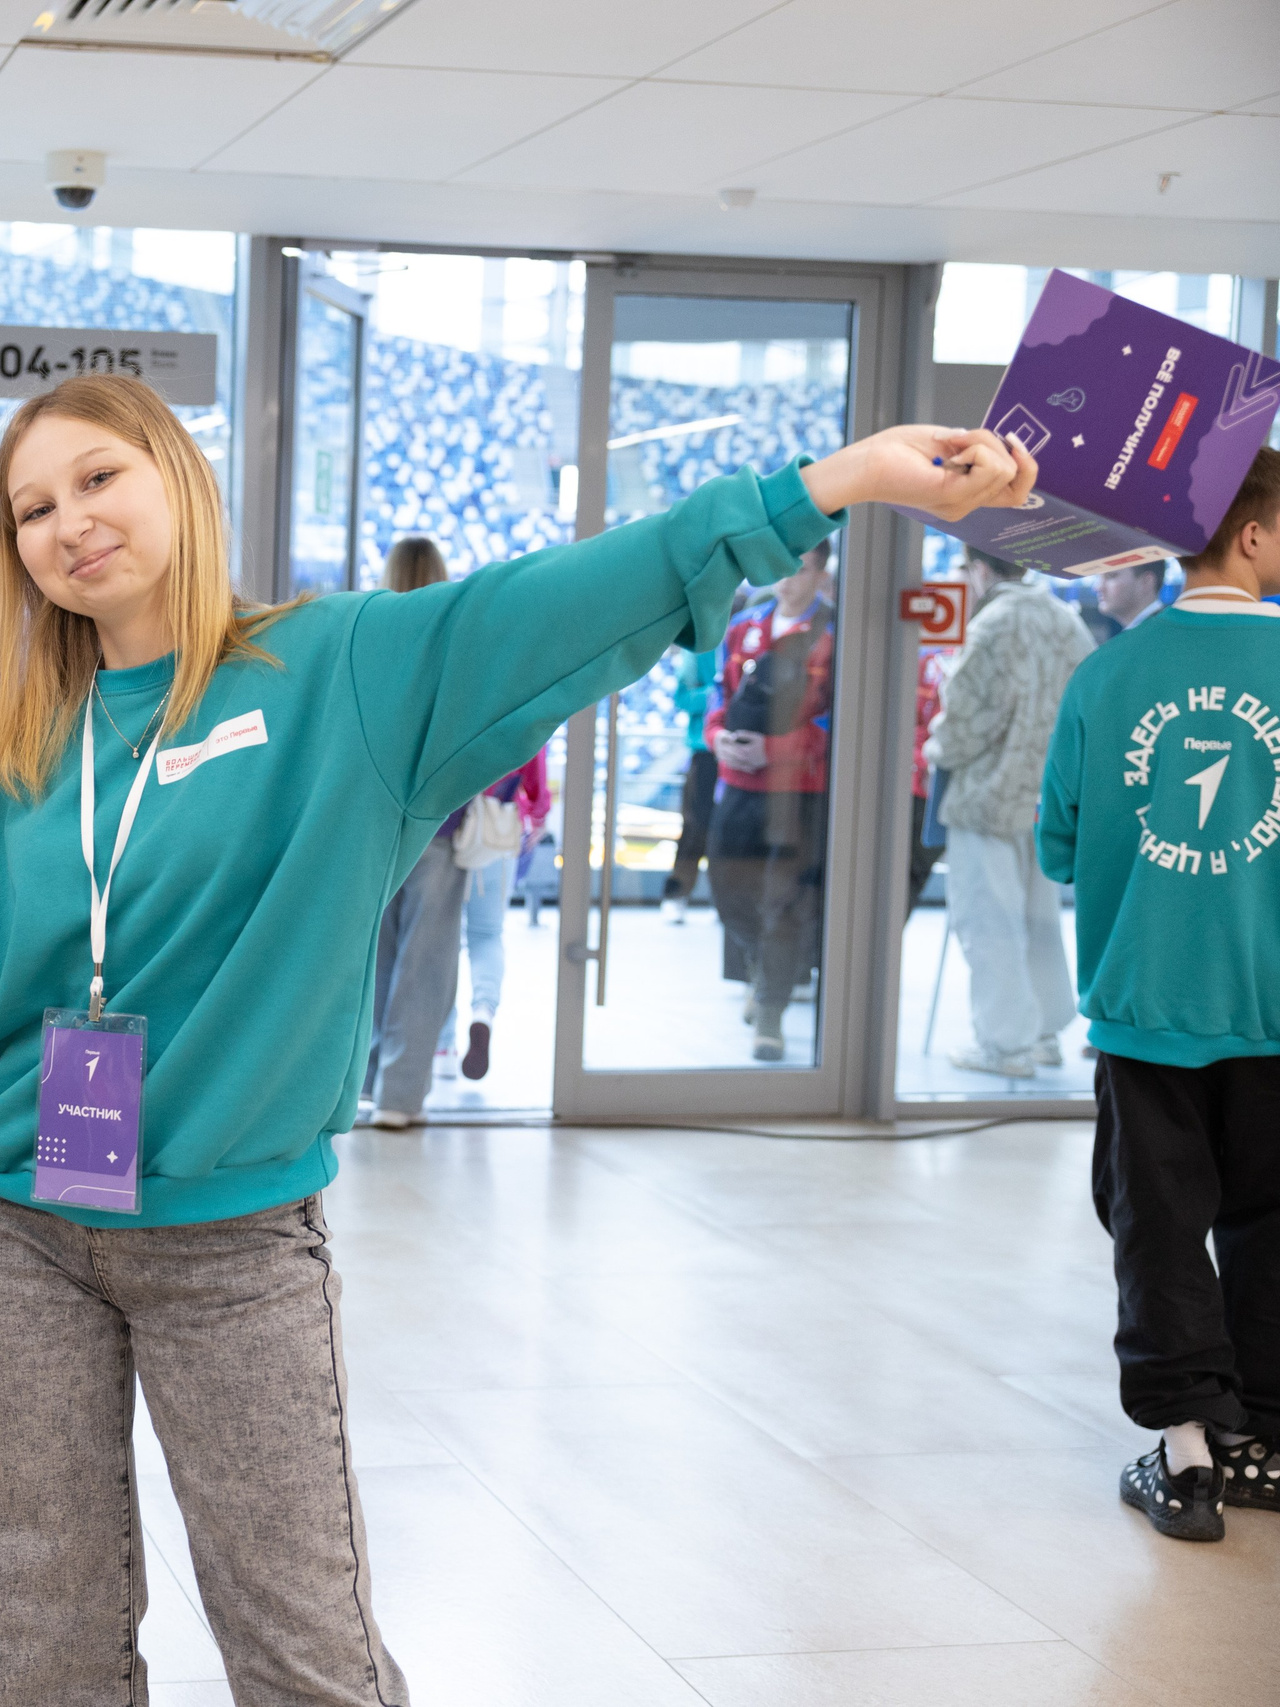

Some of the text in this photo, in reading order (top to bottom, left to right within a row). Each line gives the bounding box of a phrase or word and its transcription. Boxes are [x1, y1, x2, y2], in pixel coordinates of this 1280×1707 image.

[1104, 346, 1182, 490] ВСЁ ПОЛУЧИТСЯ!
[229, 725, 258, 738] Первые
[1124, 701, 1180, 787] ЗДЕСЬ
[1188, 686, 1226, 711] НЕ
[1184, 737, 1232, 753] Первые
[58, 1103, 122, 1121] УЧАСТНИК
